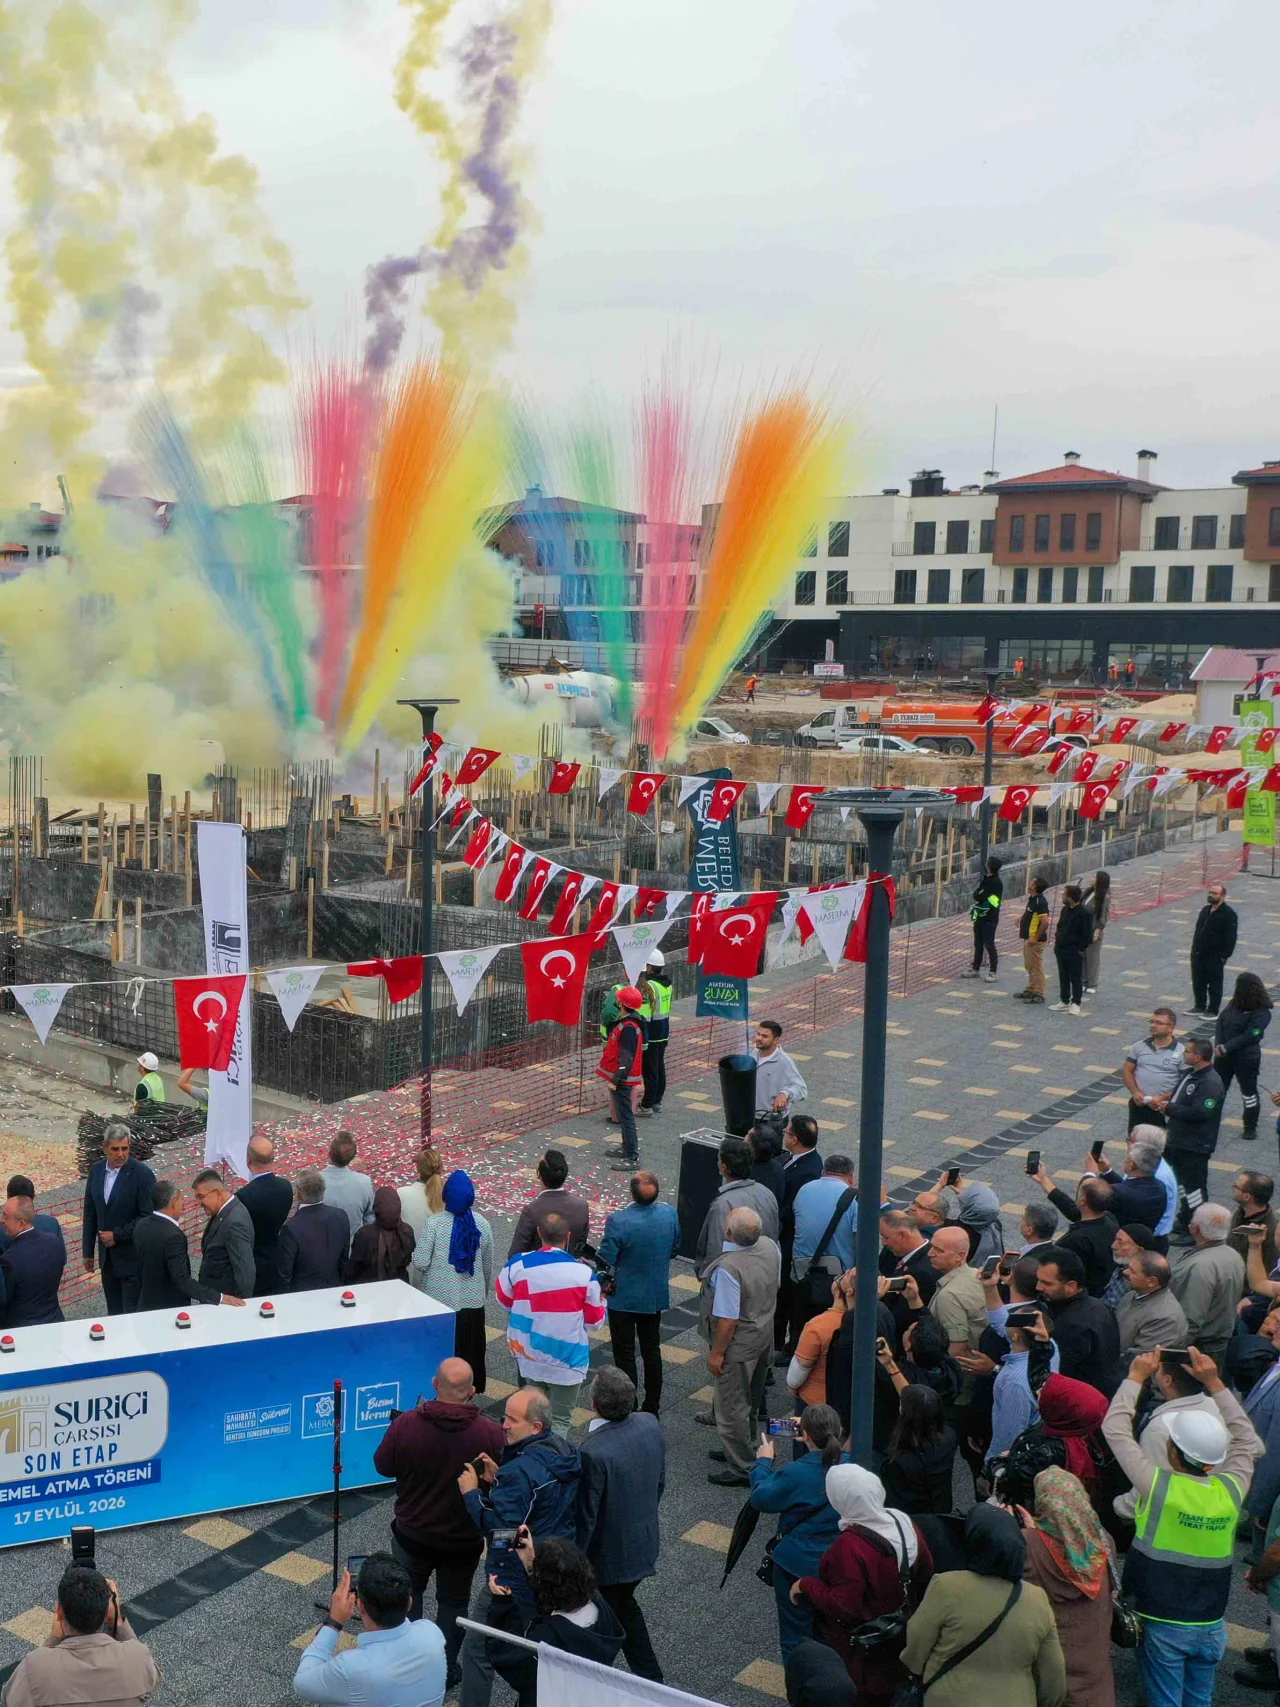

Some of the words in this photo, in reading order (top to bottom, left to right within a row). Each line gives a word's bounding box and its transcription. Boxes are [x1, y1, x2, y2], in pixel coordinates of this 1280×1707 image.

[54, 1391, 148, 1428] SURİÇİ
[54, 1423, 120, 1446] ÇARŞISI
[24, 1451, 61, 1474] SON
[72, 1442, 118, 1466] ETAP
[44, 1477, 90, 1495] ATMA
[94, 1463, 152, 1487] TÖRENİ
[14, 1511, 31, 1525] 17
[34, 1502, 85, 1522] EYLÜL
[88, 1496, 126, 1513] 2026
